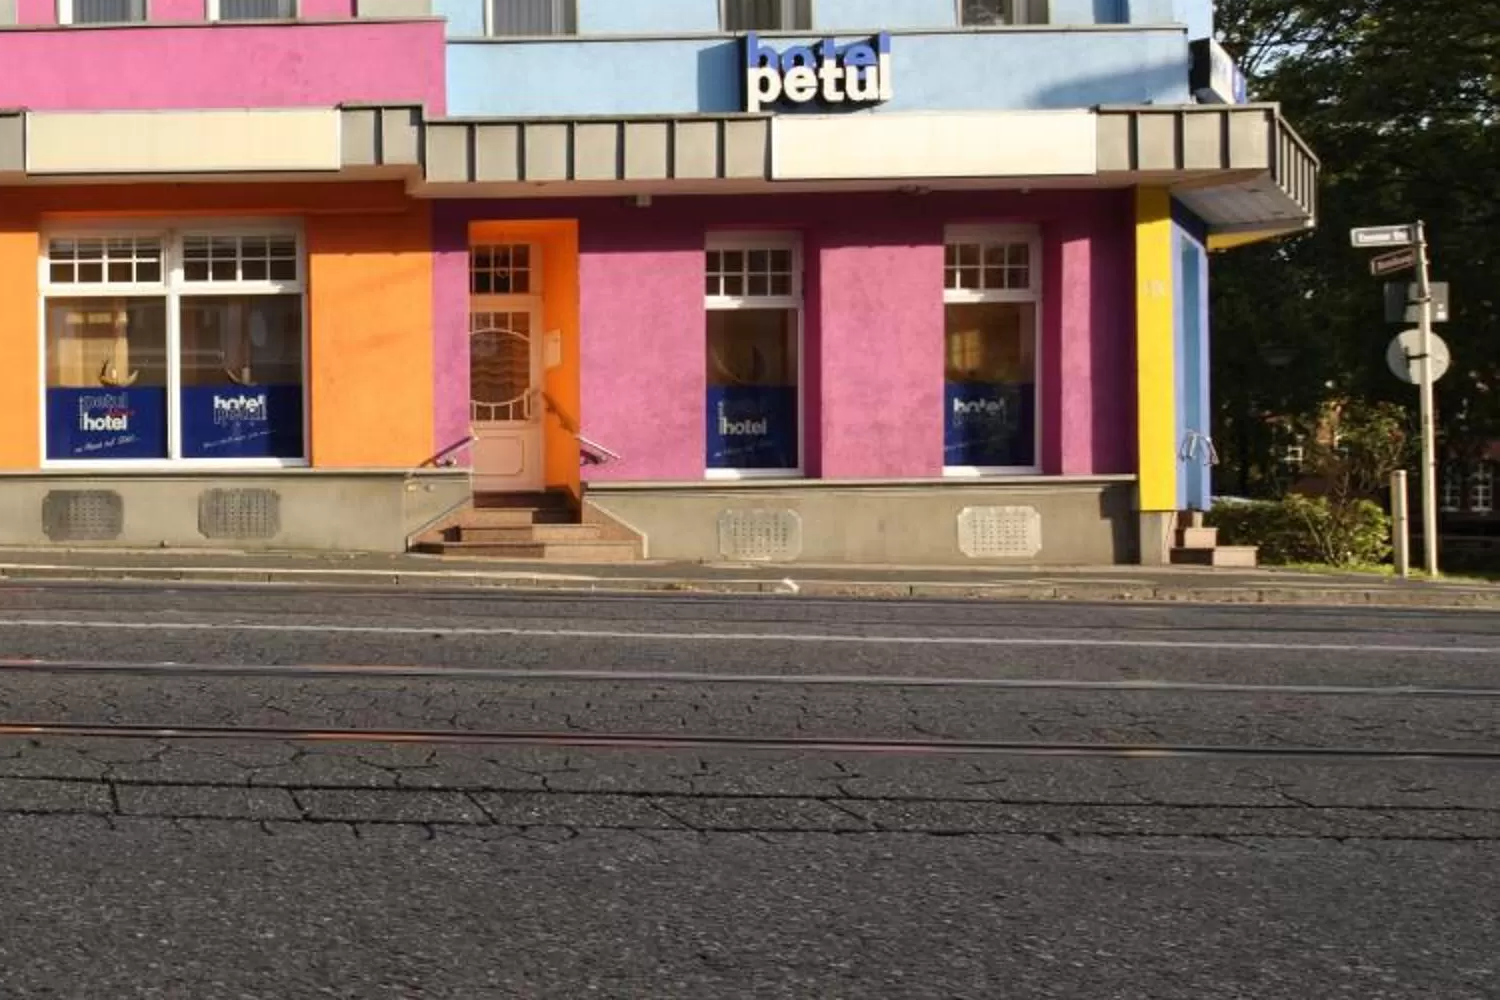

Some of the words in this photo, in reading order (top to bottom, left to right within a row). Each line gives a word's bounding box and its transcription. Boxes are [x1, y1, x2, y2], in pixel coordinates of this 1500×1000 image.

[747, 53, 893, 112] petul
[214, 394, 265, 412] hotel
[83, 412, 127, 431] hotel
[719, 416, 767, 435] hotel
